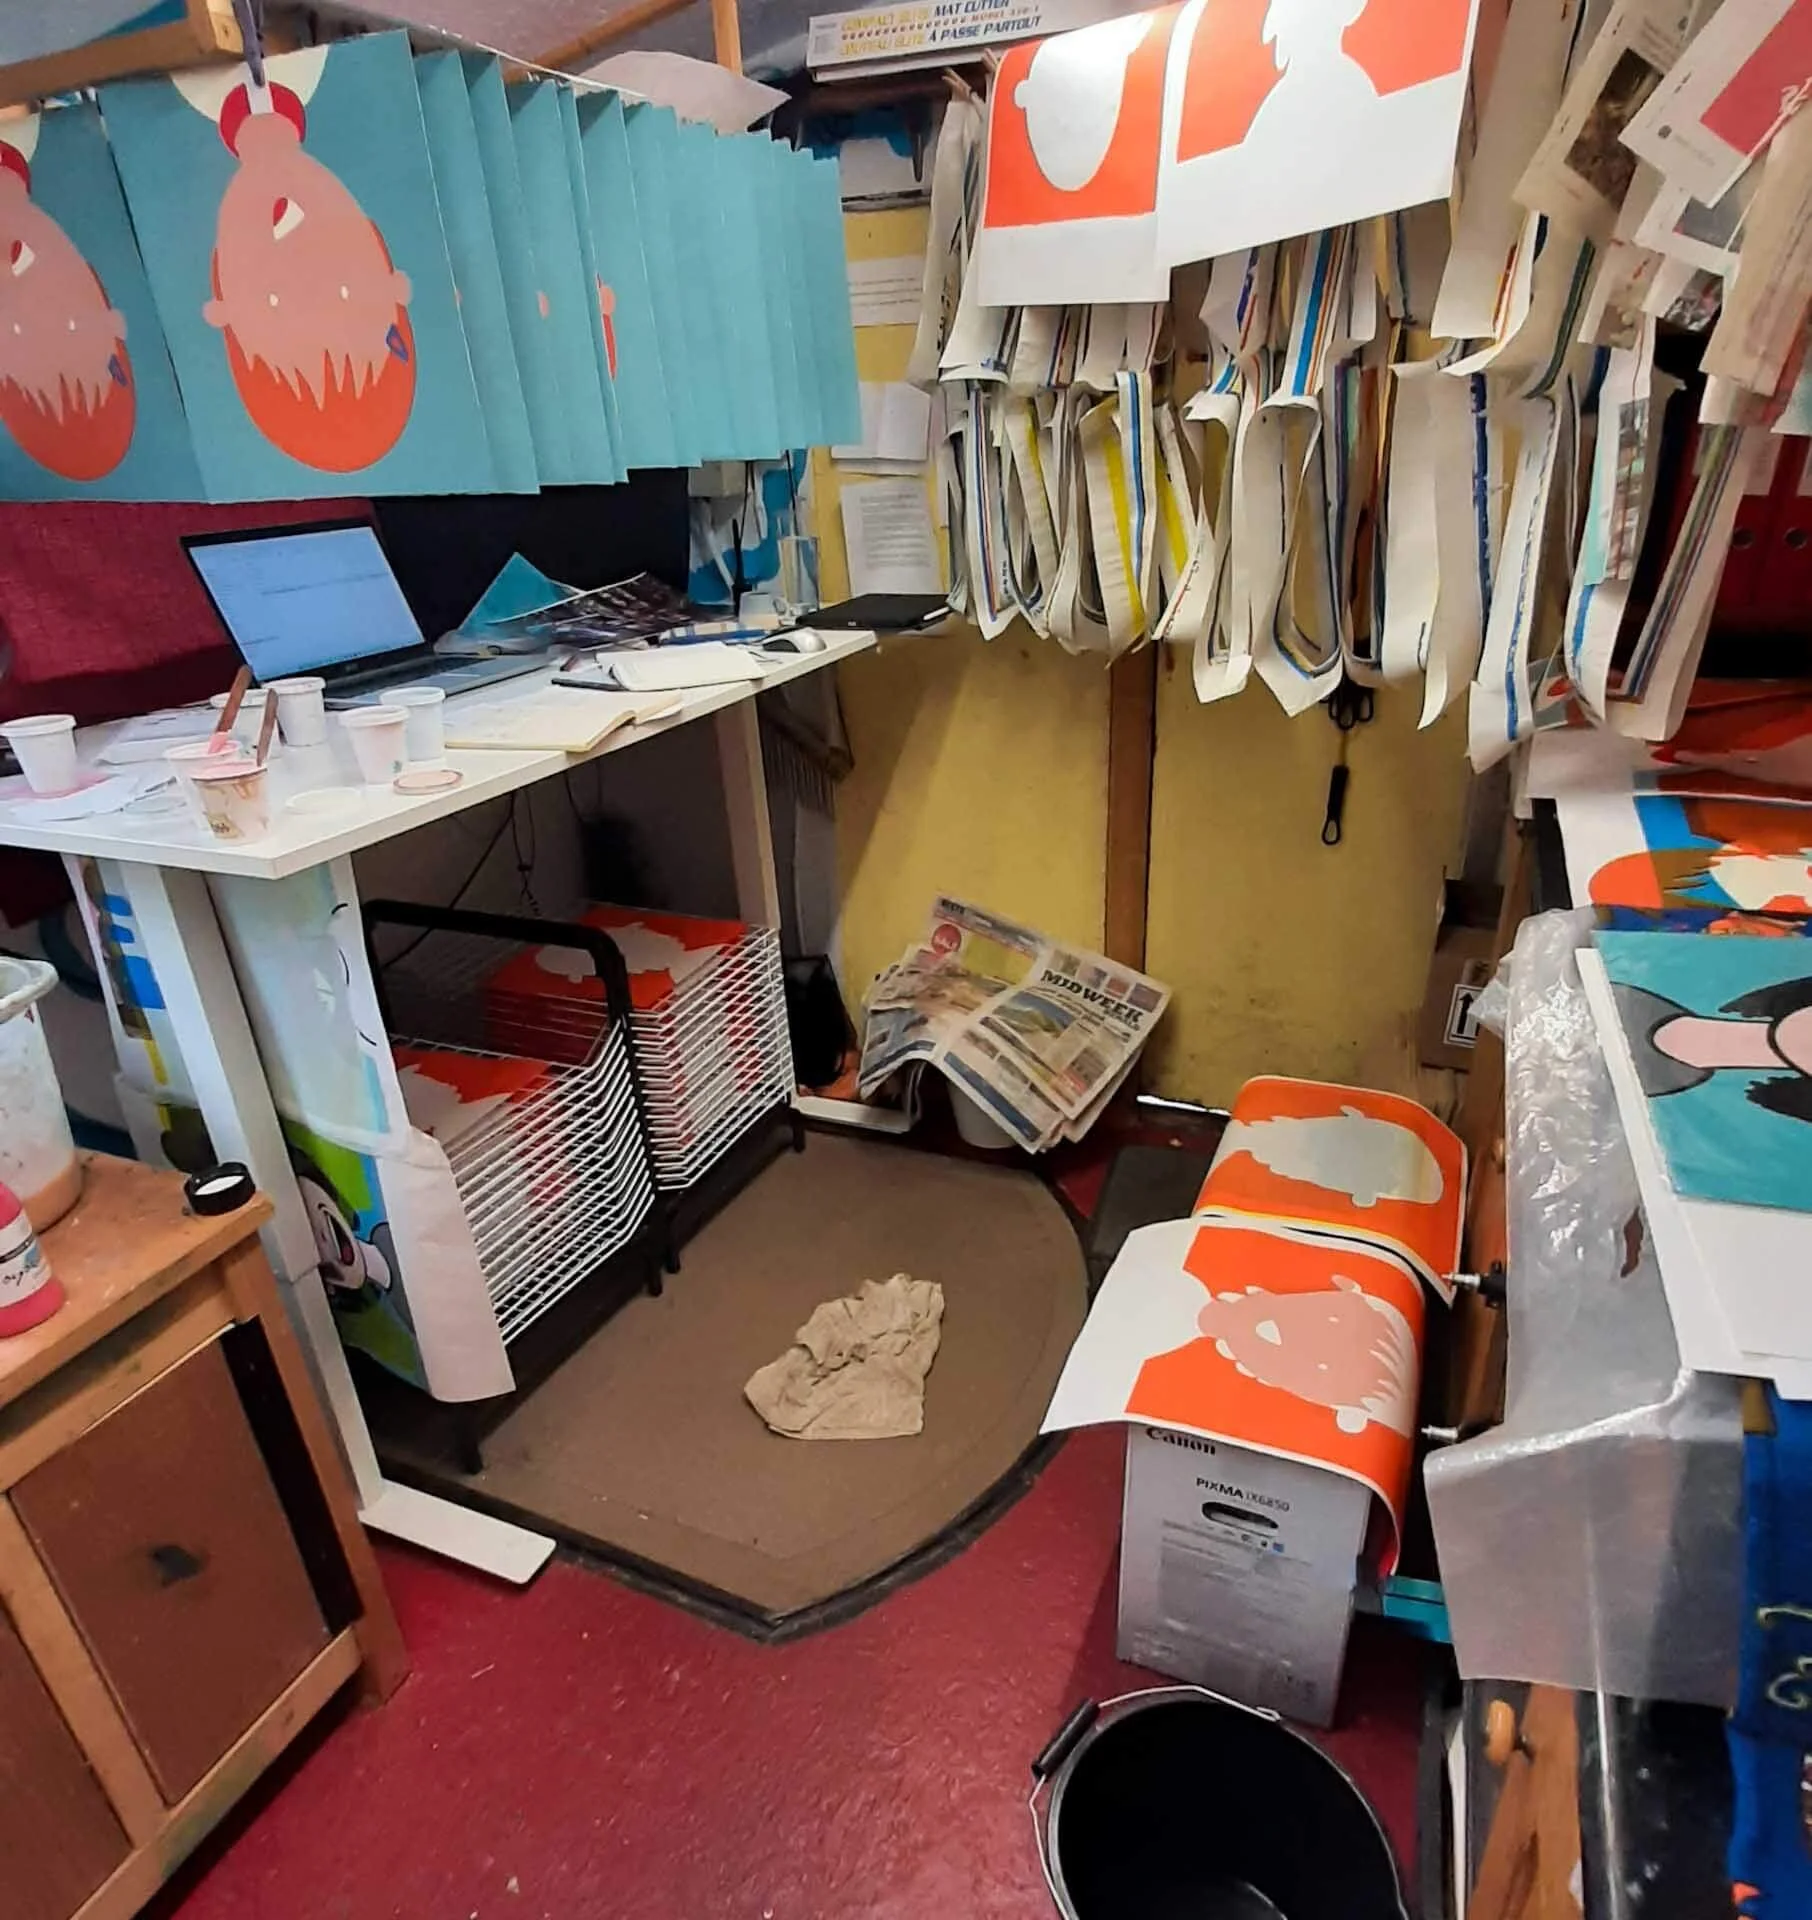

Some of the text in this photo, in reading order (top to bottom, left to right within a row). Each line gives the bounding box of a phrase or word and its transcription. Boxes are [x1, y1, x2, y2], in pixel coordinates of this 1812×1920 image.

[934, 2, 962, 18] MAT
[964, 0, 1009, 14] CUTTER
[939, 24, 981, 42] PASSE
[983, 14, 1043, 36] PARTOUT
[1040, 969, 1144, 1023] MIDWEEK
[1146, 1426, 1216, 1455] Canon
[1196, 1477, 1244, 1499] PIXMA
